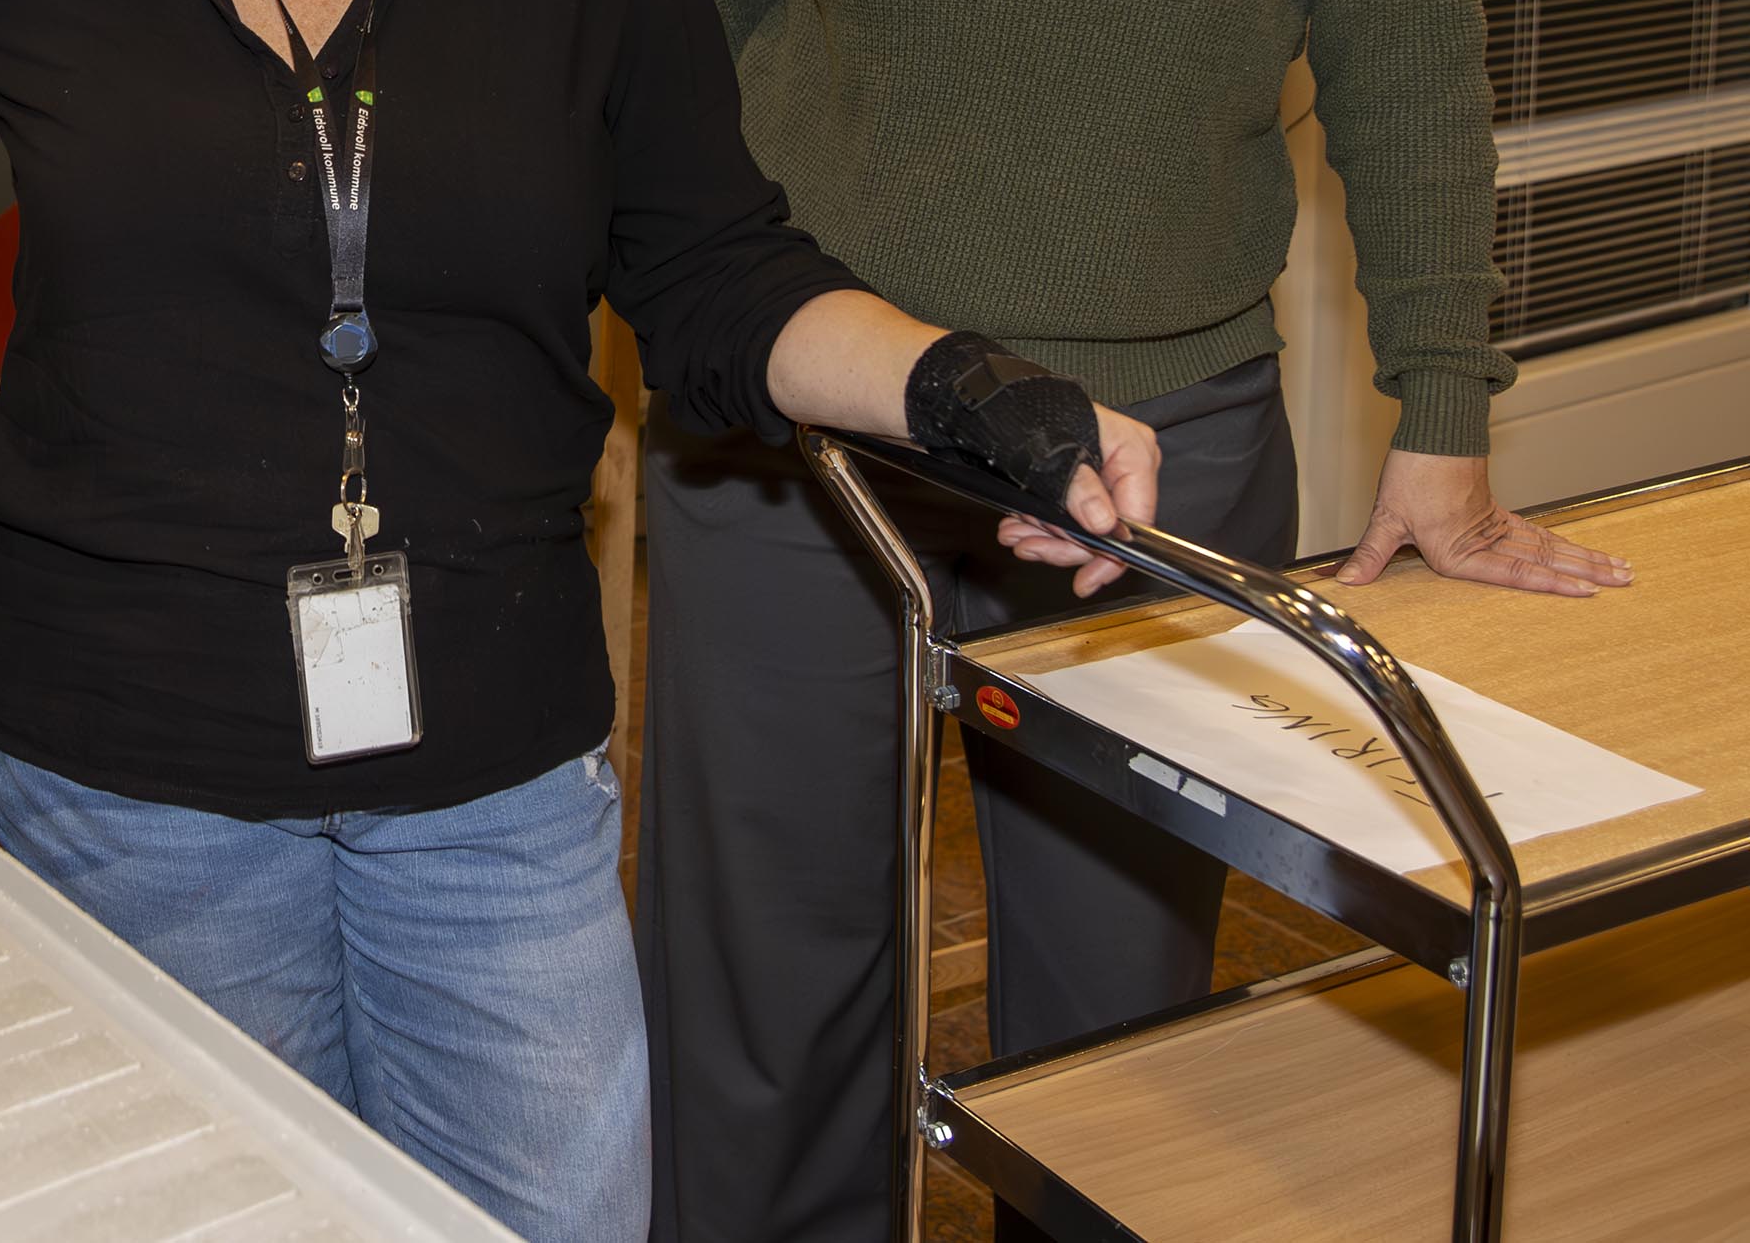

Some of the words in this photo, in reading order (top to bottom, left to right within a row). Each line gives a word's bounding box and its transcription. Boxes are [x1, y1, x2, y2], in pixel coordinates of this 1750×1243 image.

[313, 108, 332, 150] Eidsvoll
[323, 153, 340, 210] kommune
[355, 108, 369, 151] Eidsvoll
[349, 152, 365, 211] kommune
